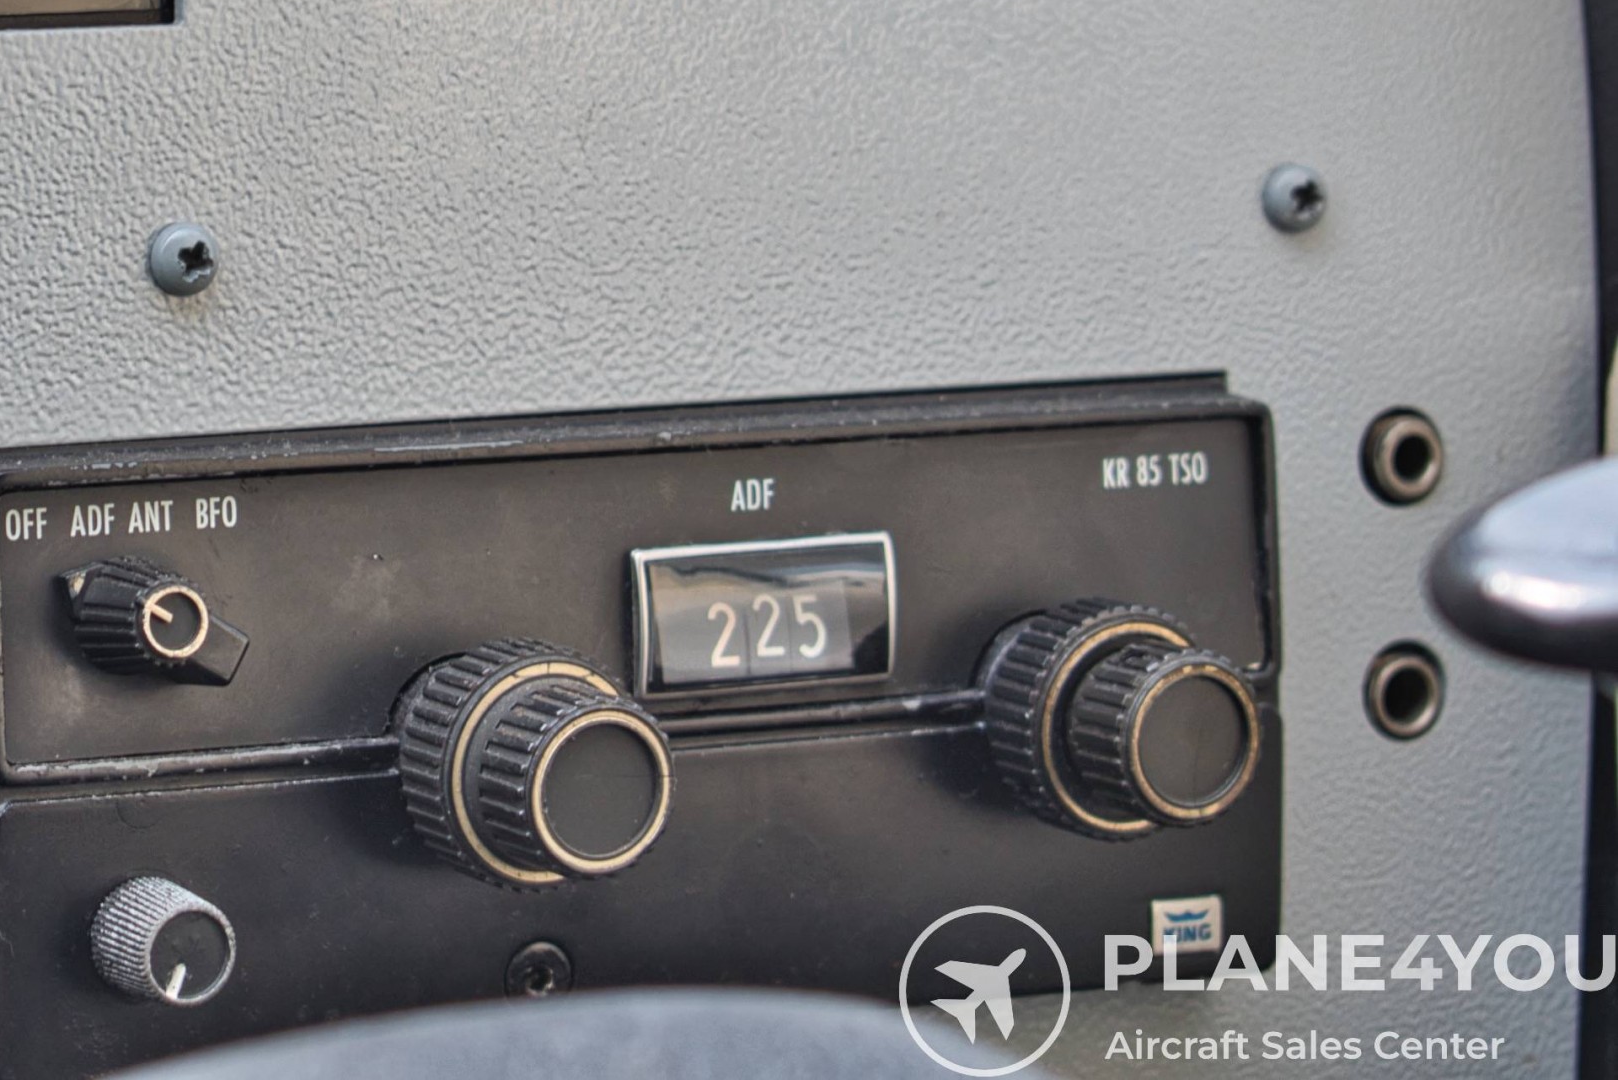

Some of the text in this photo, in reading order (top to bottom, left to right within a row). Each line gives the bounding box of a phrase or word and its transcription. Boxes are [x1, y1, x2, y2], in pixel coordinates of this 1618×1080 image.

[1102, 451, 1208, 489] KR 85 TSO
[730, 477, 775, 512] ADF
[5, 495, 237, 541] OFF ADF ANT BFO
[707, 592, 828, 669] 225
